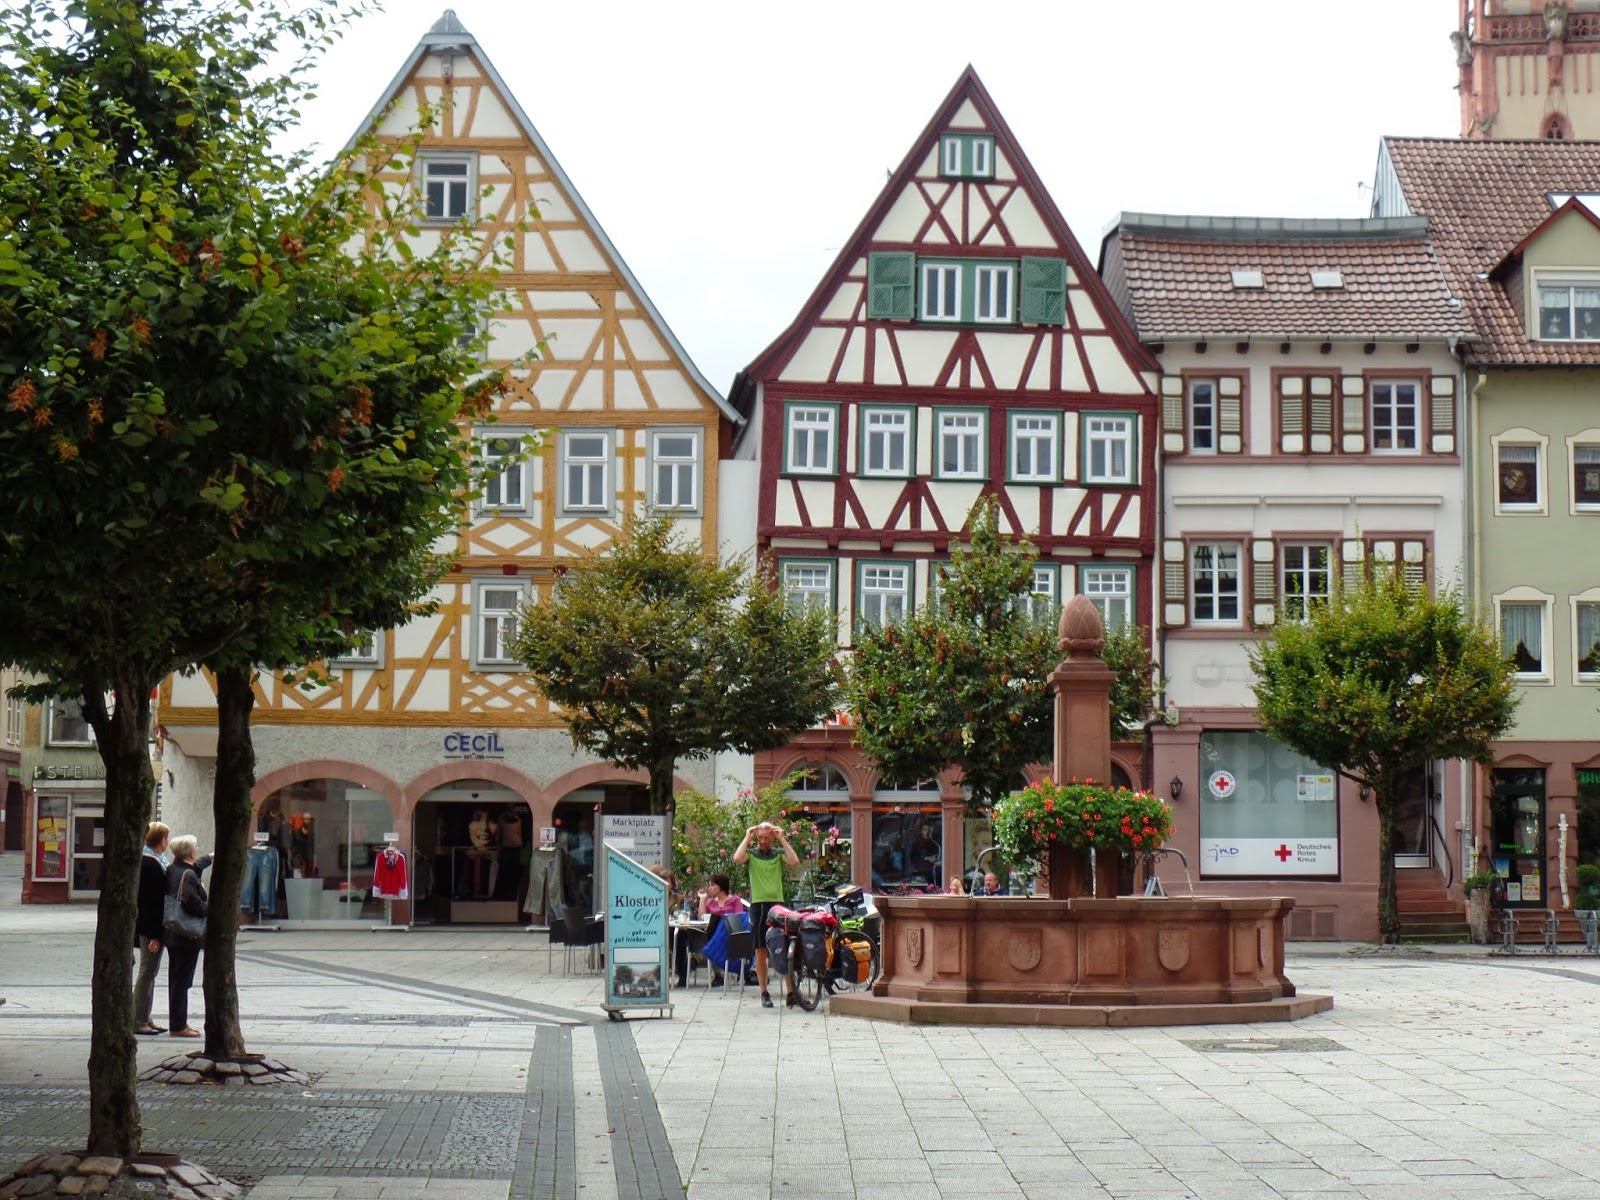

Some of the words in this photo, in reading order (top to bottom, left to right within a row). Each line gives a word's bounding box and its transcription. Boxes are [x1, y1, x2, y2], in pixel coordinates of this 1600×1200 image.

[444, 735, 505, 752] CECIL
[612, 818, 655, 828] Marktplatz
[614, 895, 662, 908] Kloster
